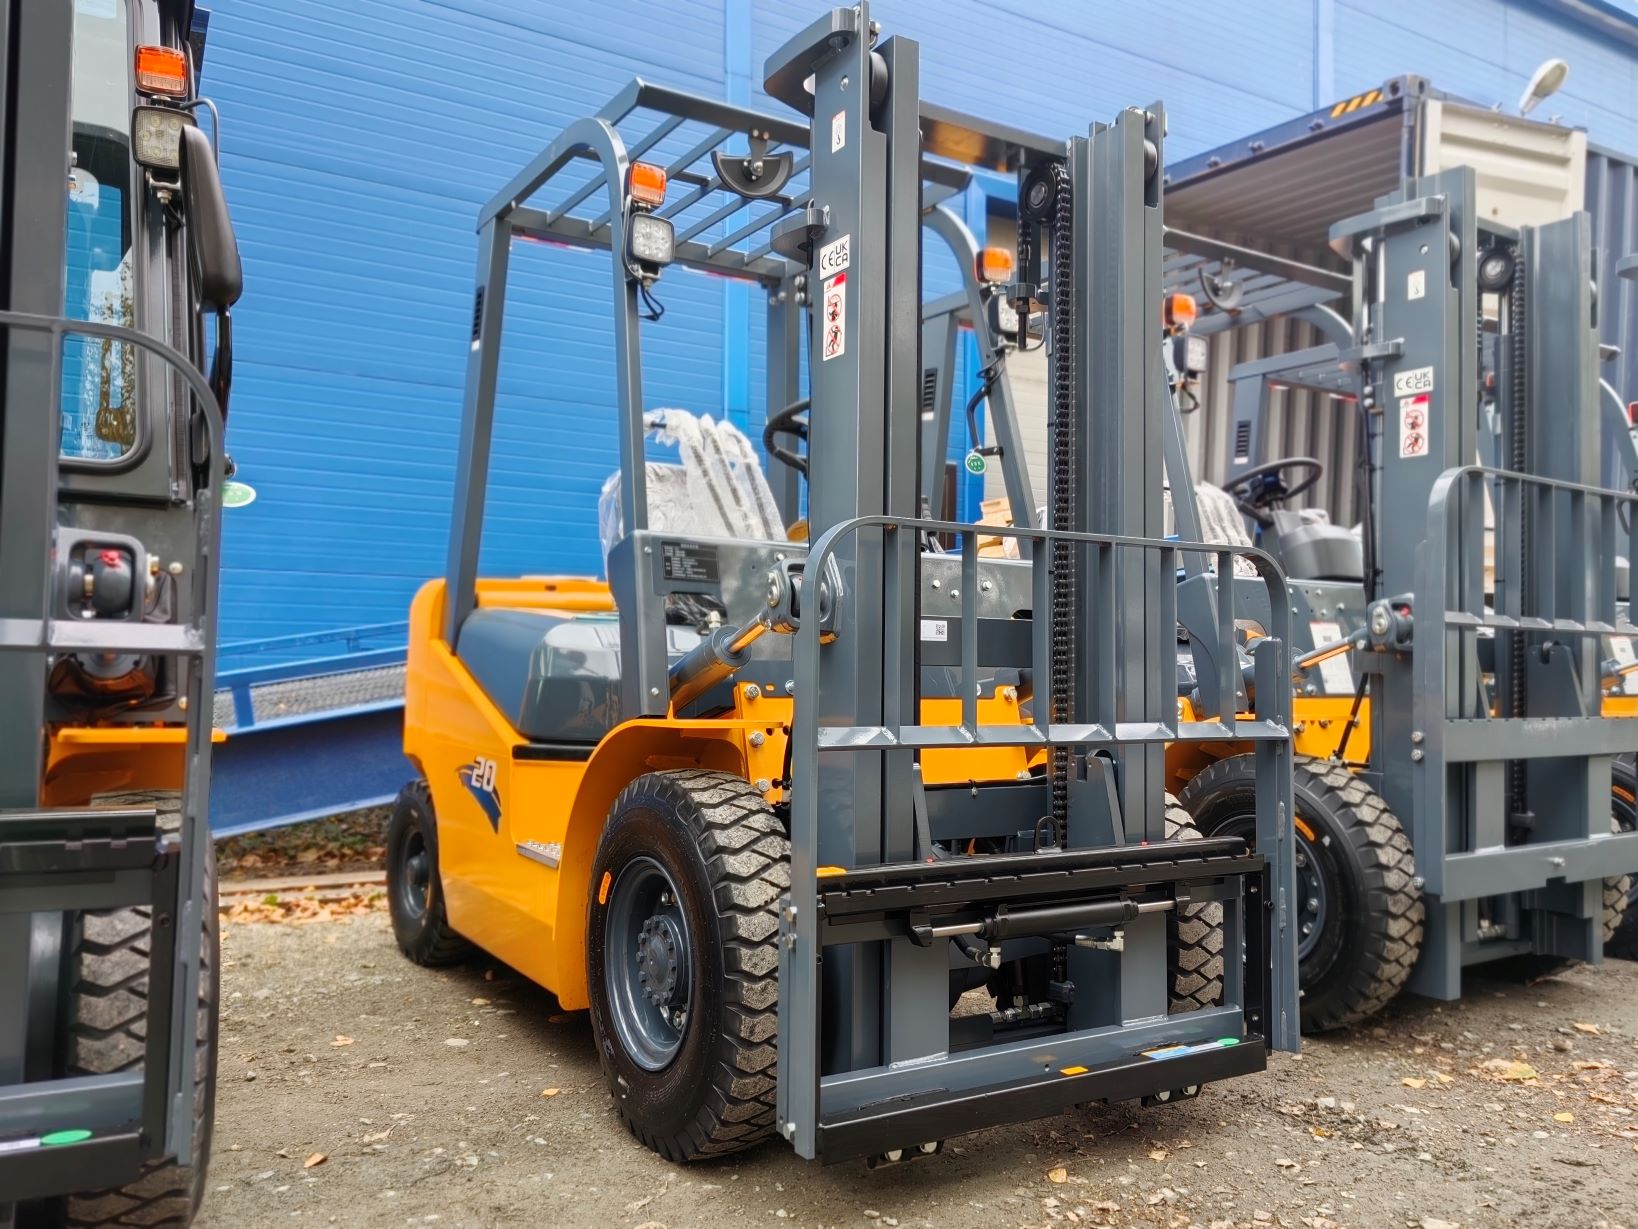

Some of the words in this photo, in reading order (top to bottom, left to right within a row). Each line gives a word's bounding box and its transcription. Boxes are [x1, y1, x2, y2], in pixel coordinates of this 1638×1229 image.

[835, 240, 848, 255] UK
[835, 252, 849, 267] CA
[471, 755, 497, 793] 20
